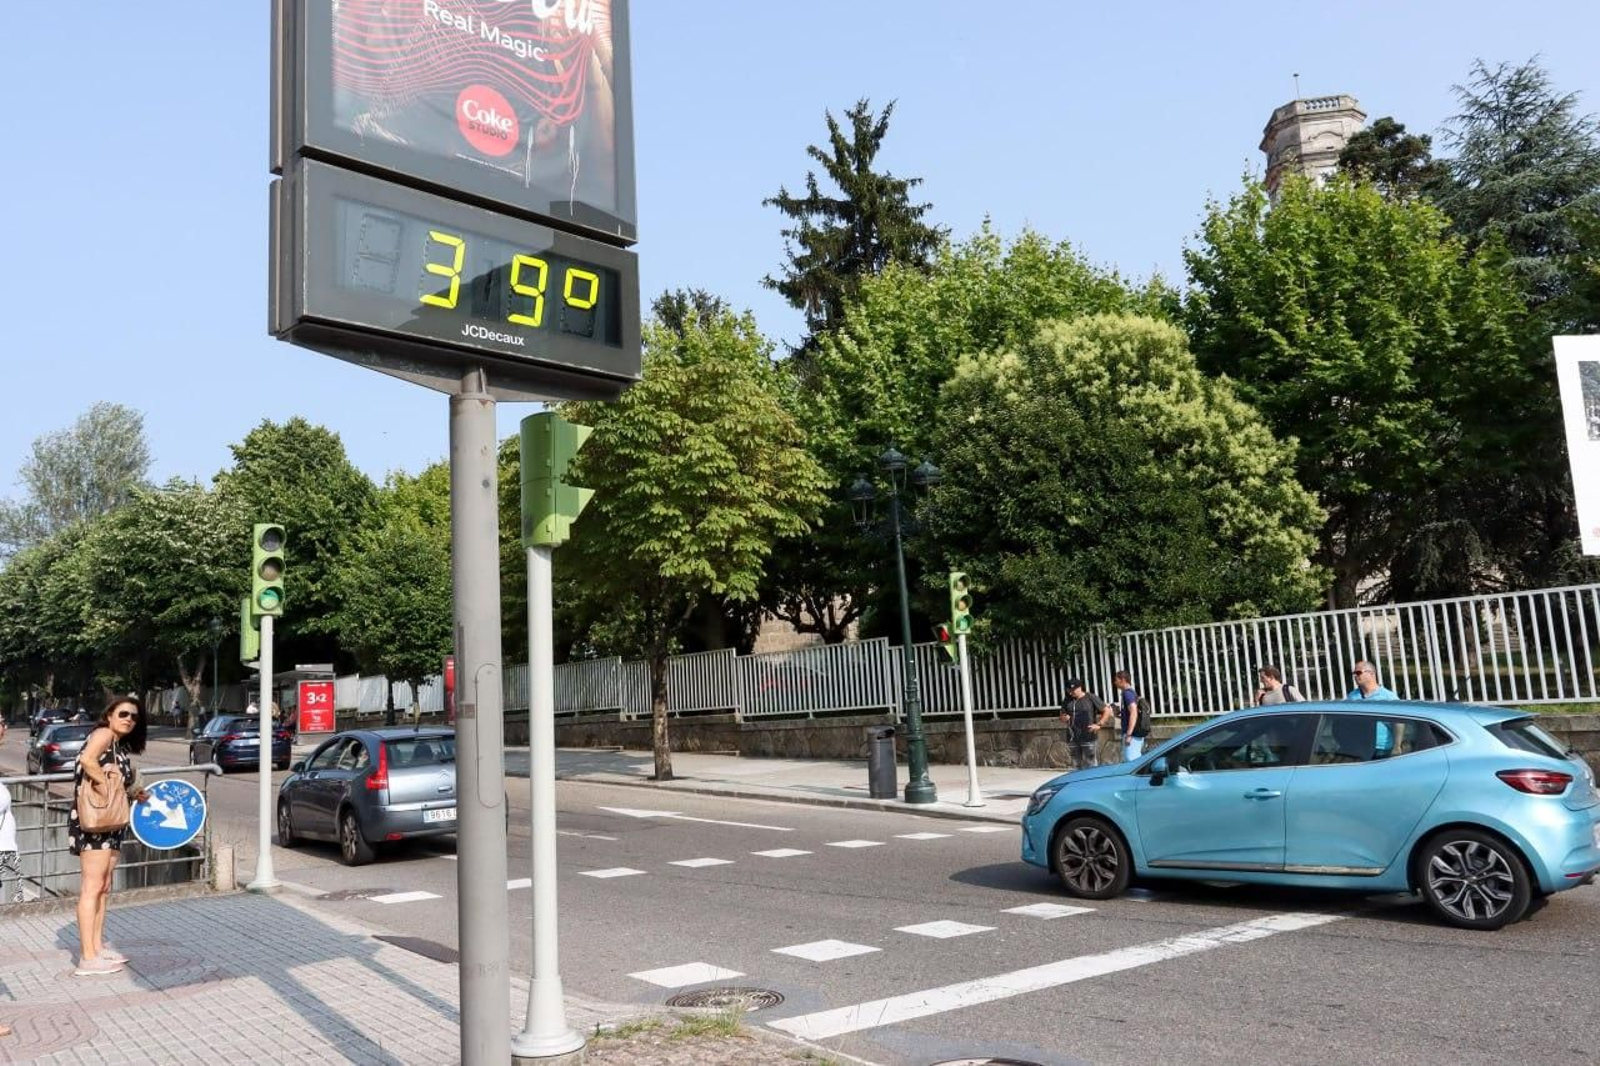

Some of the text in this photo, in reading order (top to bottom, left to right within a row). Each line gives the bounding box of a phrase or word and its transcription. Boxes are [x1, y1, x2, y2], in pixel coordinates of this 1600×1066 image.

[423, 0, 475, 34] Real
[481, 20, 548, 61] Magic
[462, 100, 513, 132] Coke
[468, 120, 508, 140] STUDIO
[461, 324, 525, 346] JCDecaux
